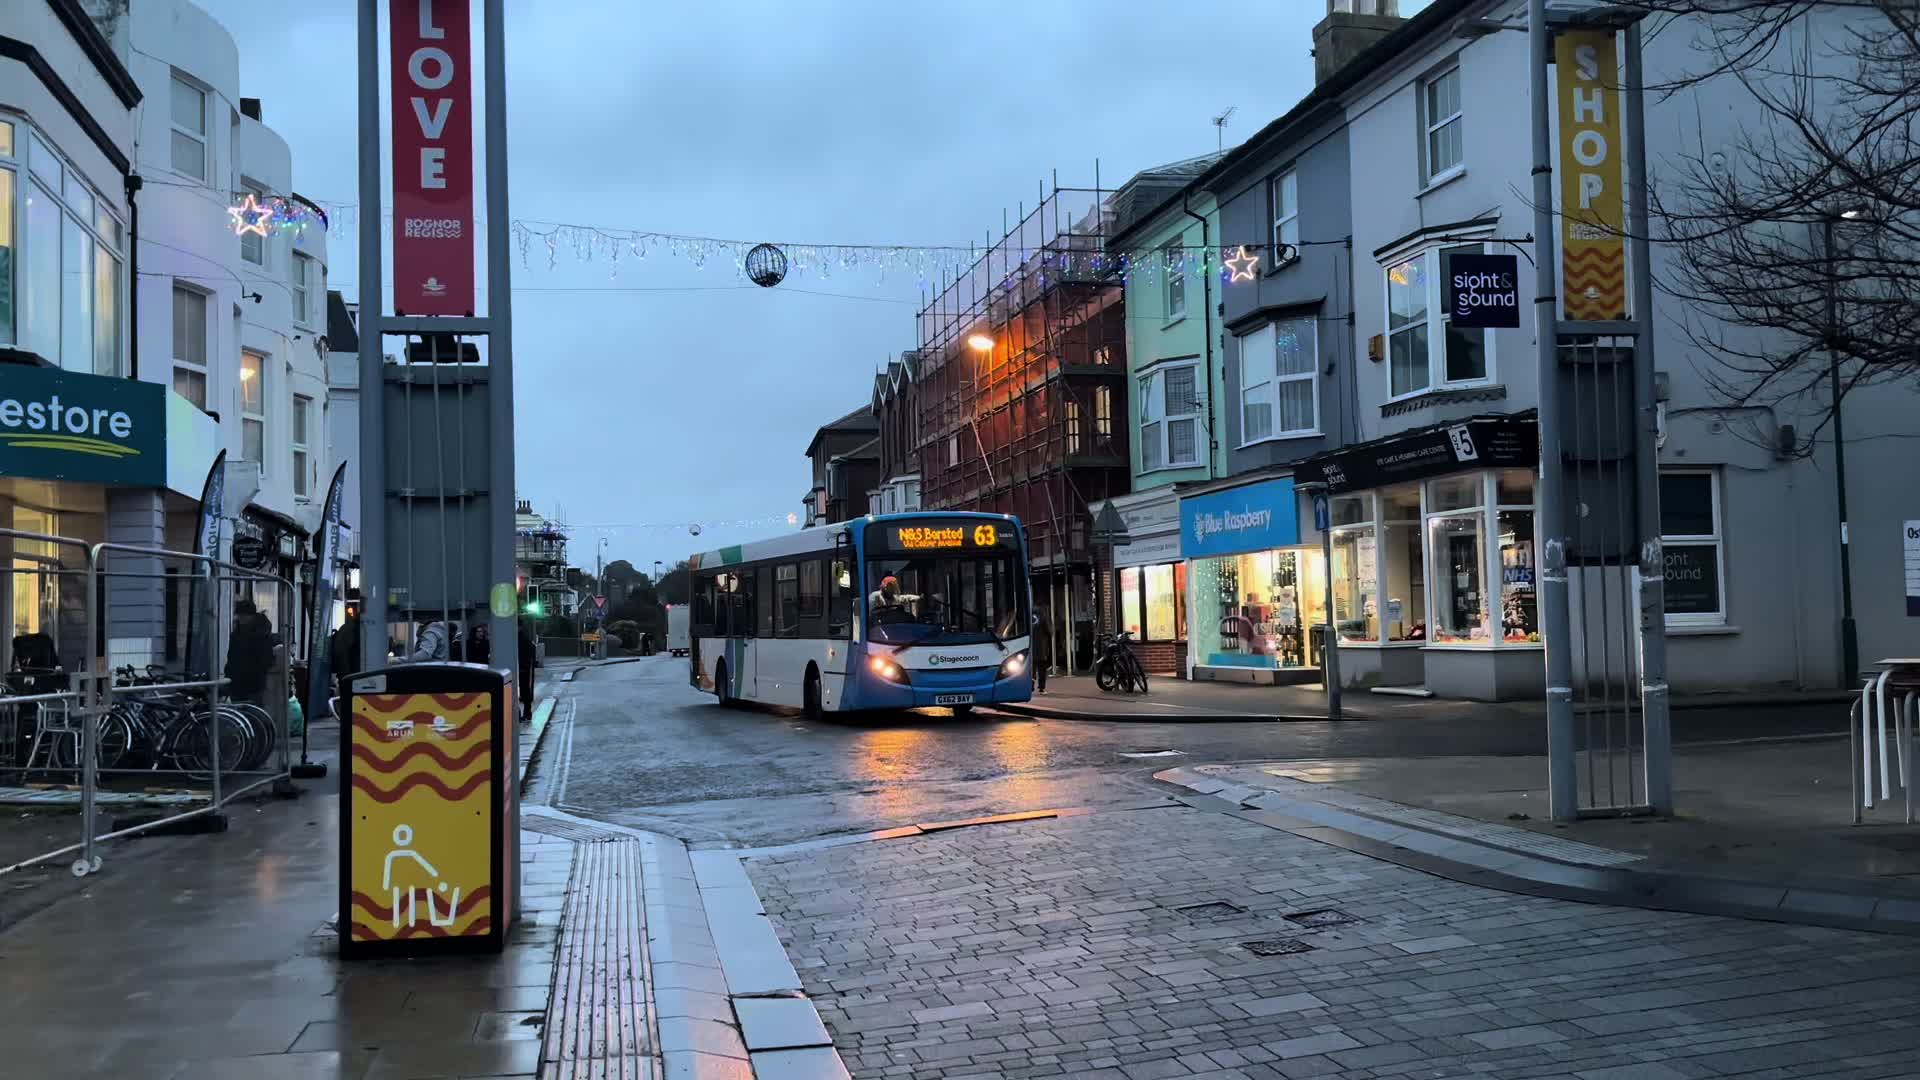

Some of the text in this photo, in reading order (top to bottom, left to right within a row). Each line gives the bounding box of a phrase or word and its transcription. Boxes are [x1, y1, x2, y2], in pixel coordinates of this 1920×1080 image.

[408, 0, 454, 189] LOVE
[1571, 45, 1608, 209] SHOP
[405, 218, 461, 229] BOGNOR
[405, 228, 444, 238] REGIS
[1458, 290, 1516, 306] sound
[0, 395, 133, 438] estore
[1204, 513, 1223, 533] Blue
[1224, 504, 1272, 535] Raspberry
[974, 524, 997, 546] 63
[1504, 569, 1532, 581] NHS
[387, 729, 414, 737] ARUN
